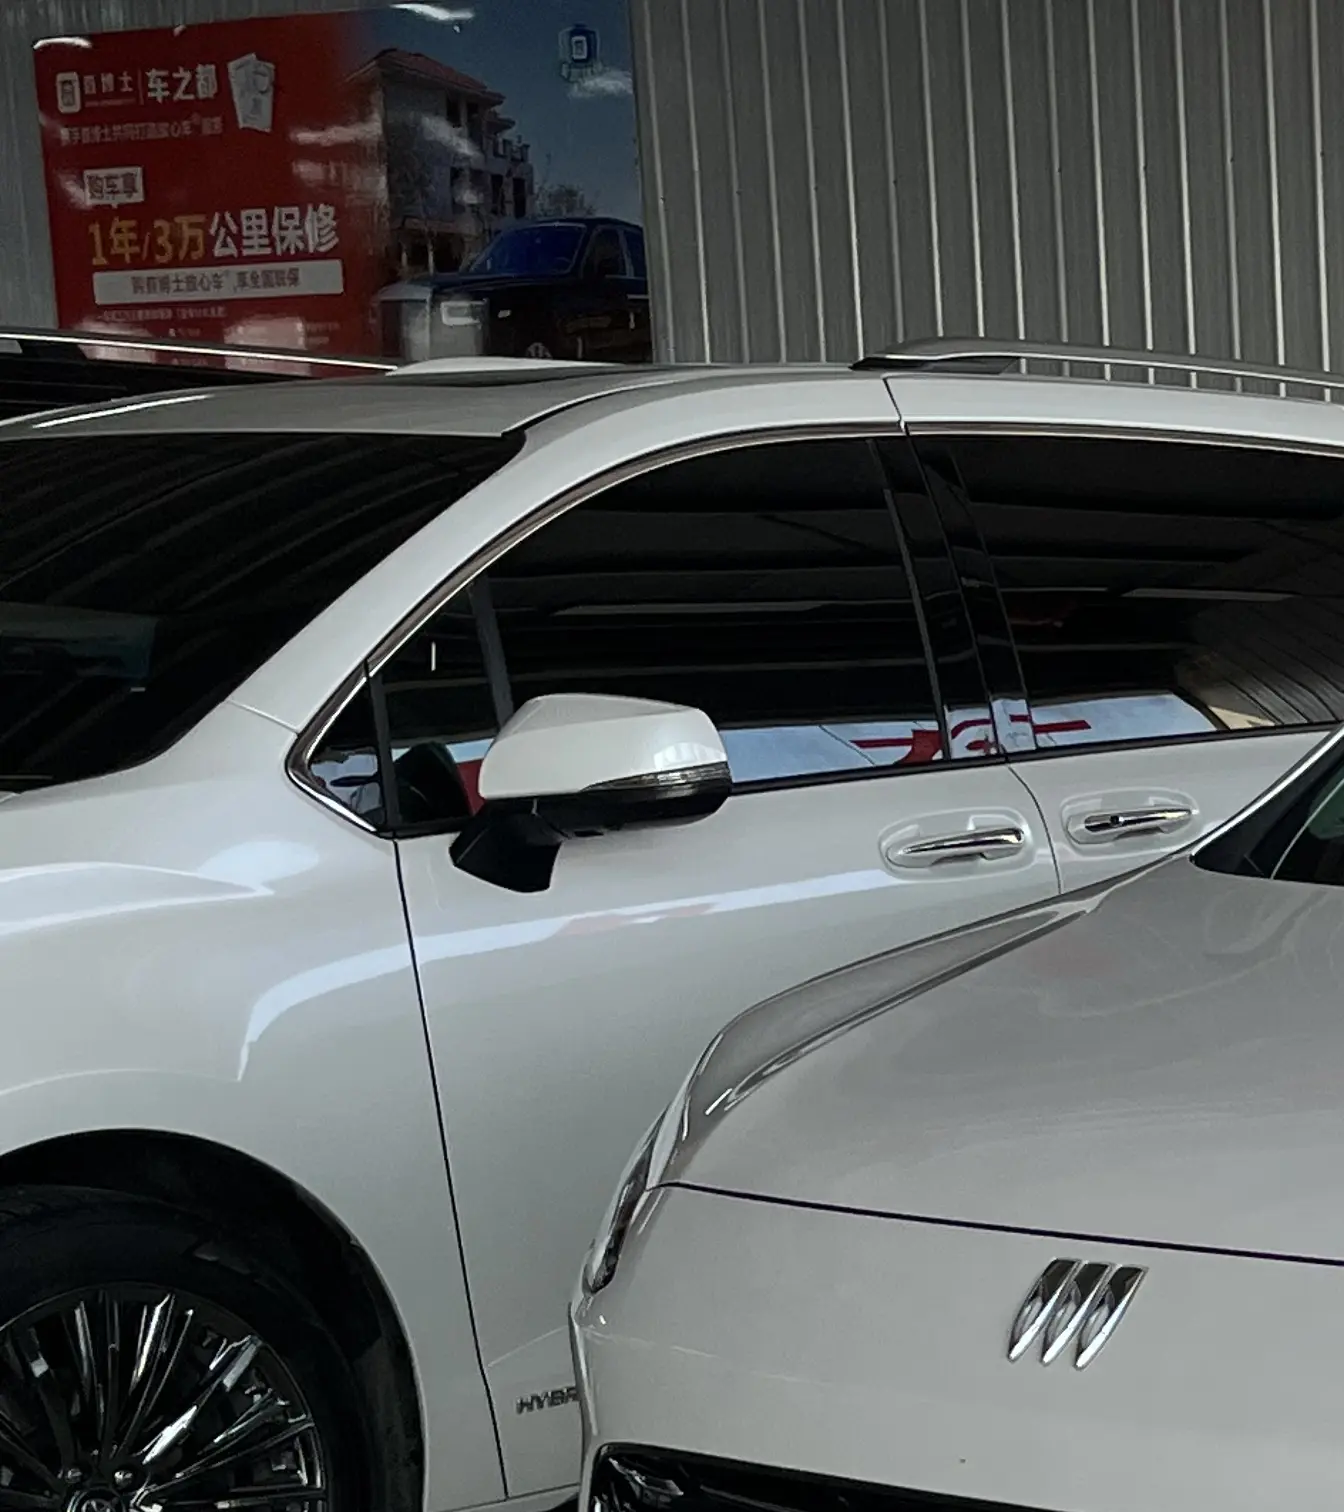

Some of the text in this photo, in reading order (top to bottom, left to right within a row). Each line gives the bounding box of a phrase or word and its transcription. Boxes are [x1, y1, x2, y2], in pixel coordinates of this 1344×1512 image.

[88, 202, 340, 266] 1年/3万公里保修
